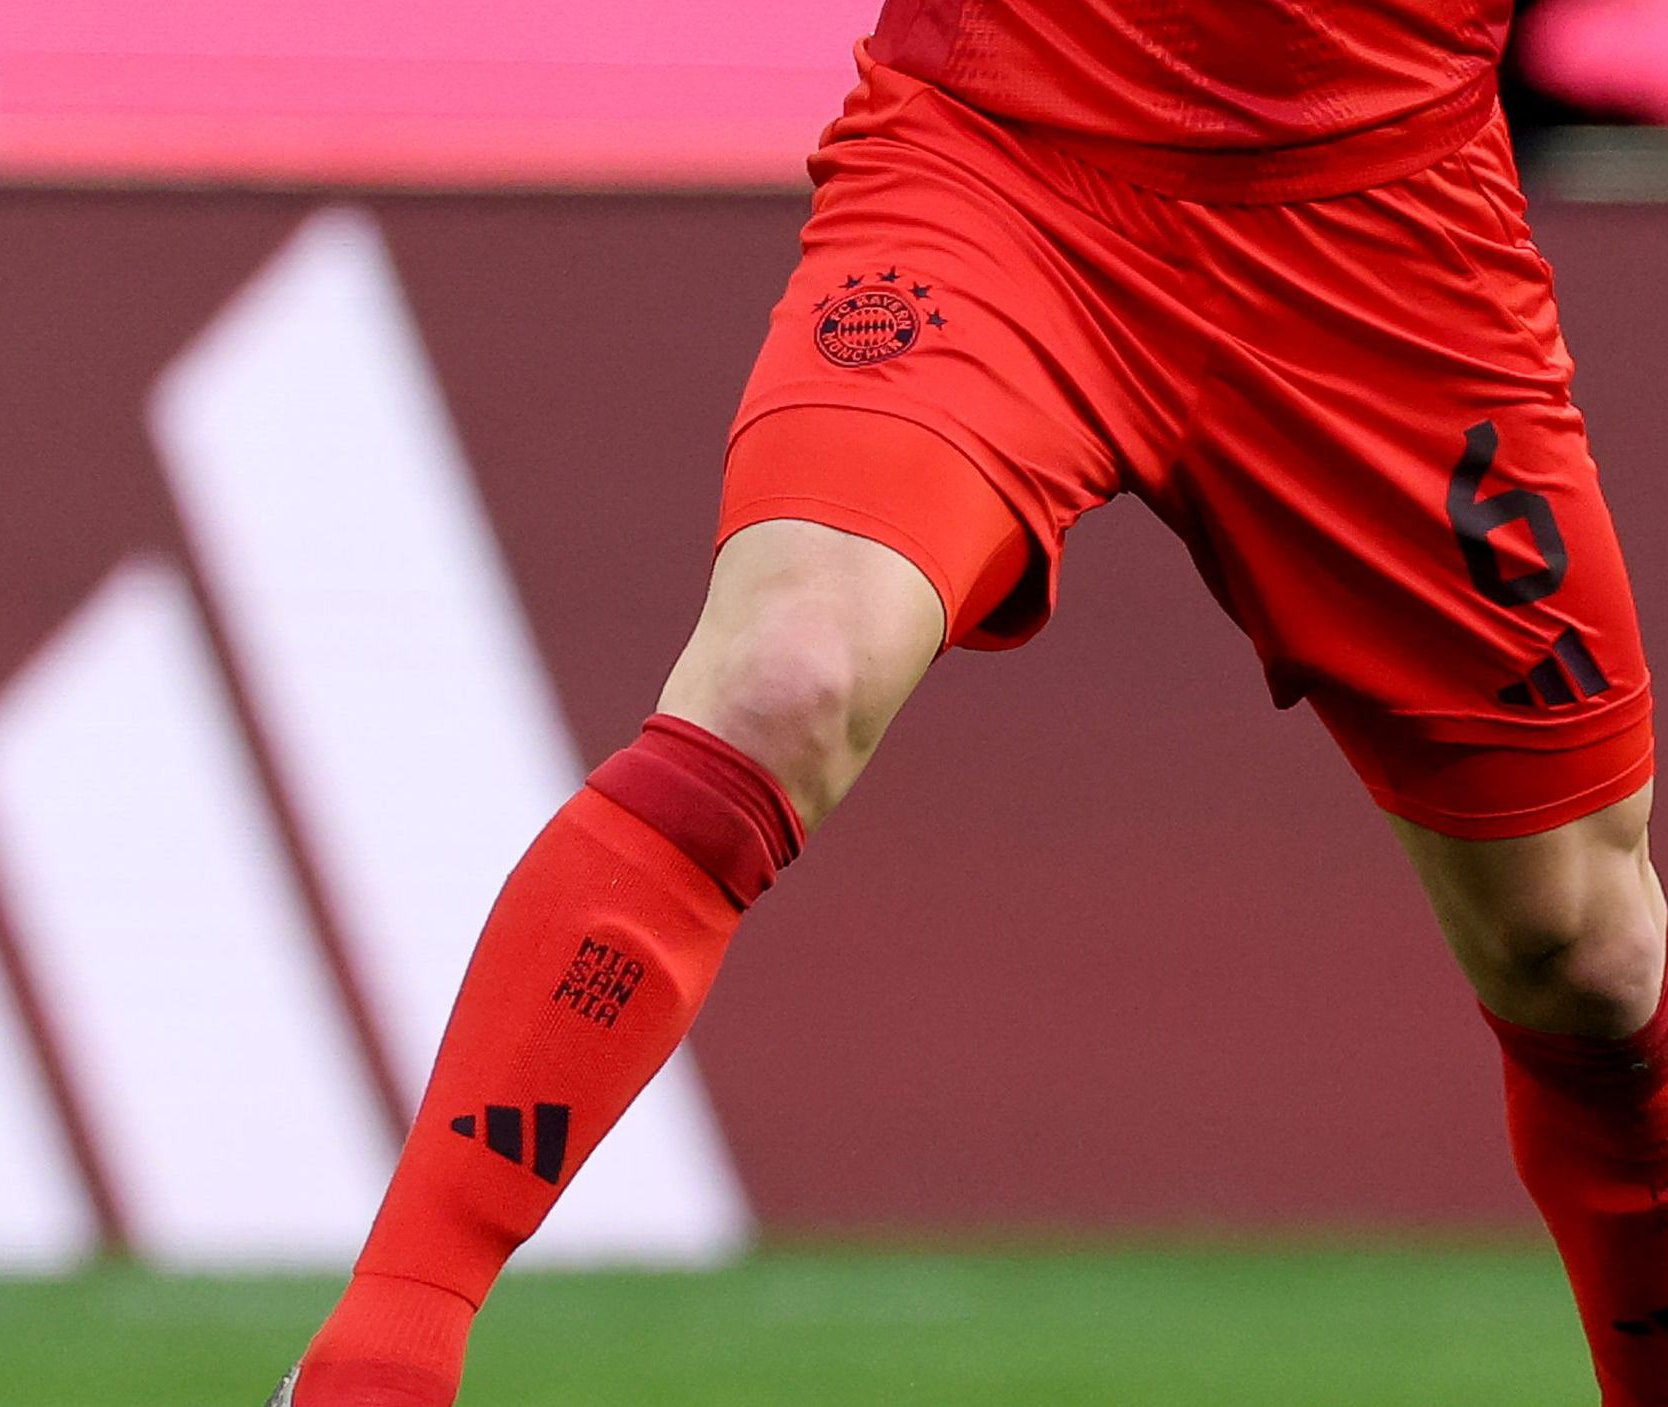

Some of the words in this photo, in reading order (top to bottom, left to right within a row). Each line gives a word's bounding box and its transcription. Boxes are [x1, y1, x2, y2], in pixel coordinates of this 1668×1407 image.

[830, 303, 851, 322] FC
[856, 295, 913, 329] BAYERN
[1447, 419, 1568, 607] 6
[565, 960, 633, 1006] SAN
[577, 936, 645, 985] MIA
[553, 979, 619, 1029] MIA
